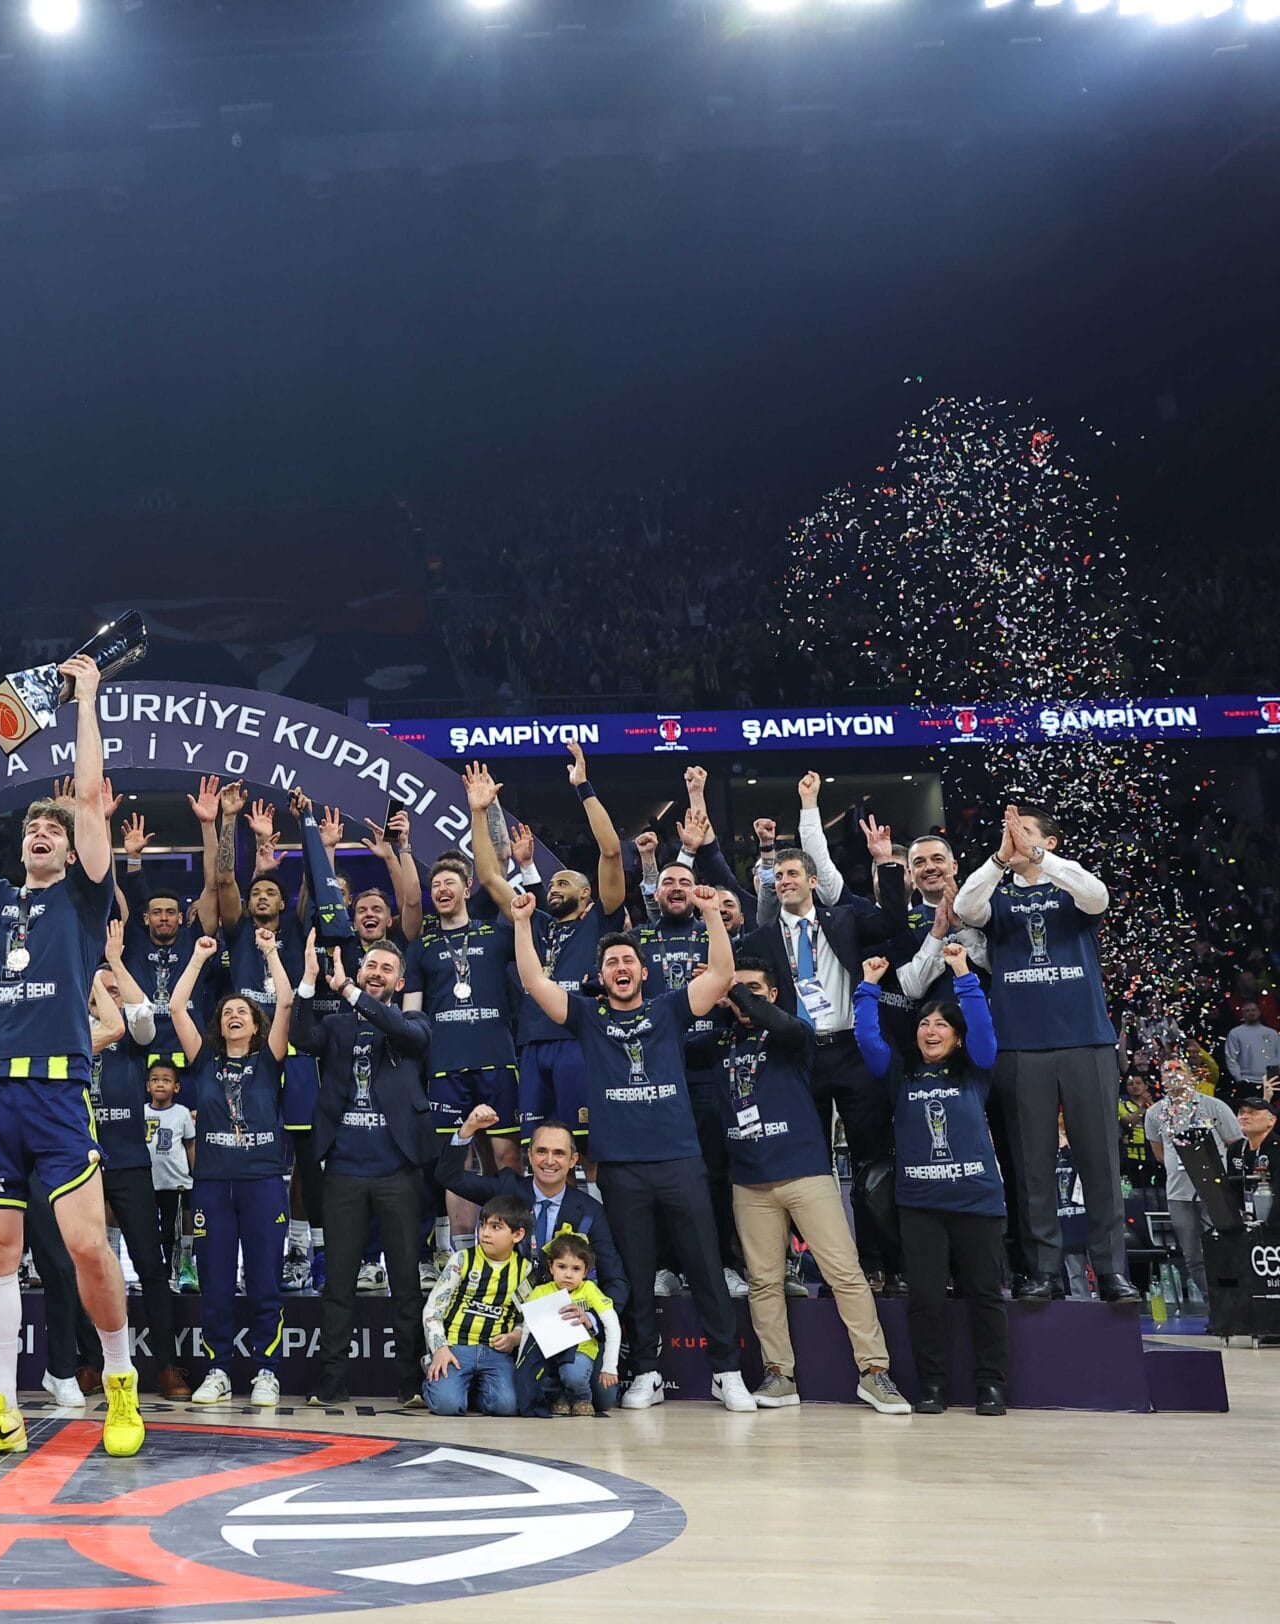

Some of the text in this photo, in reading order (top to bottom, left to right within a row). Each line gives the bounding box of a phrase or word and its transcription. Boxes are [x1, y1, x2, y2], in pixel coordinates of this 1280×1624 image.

[450, 720, 598, 753] ŞAMPİYON
[742, 712, 894, 746] ŞAMPİYON
[273, 715, 438, 815] KUPASI
[905, 1163, 962, 1182] FENERBAHÇE
